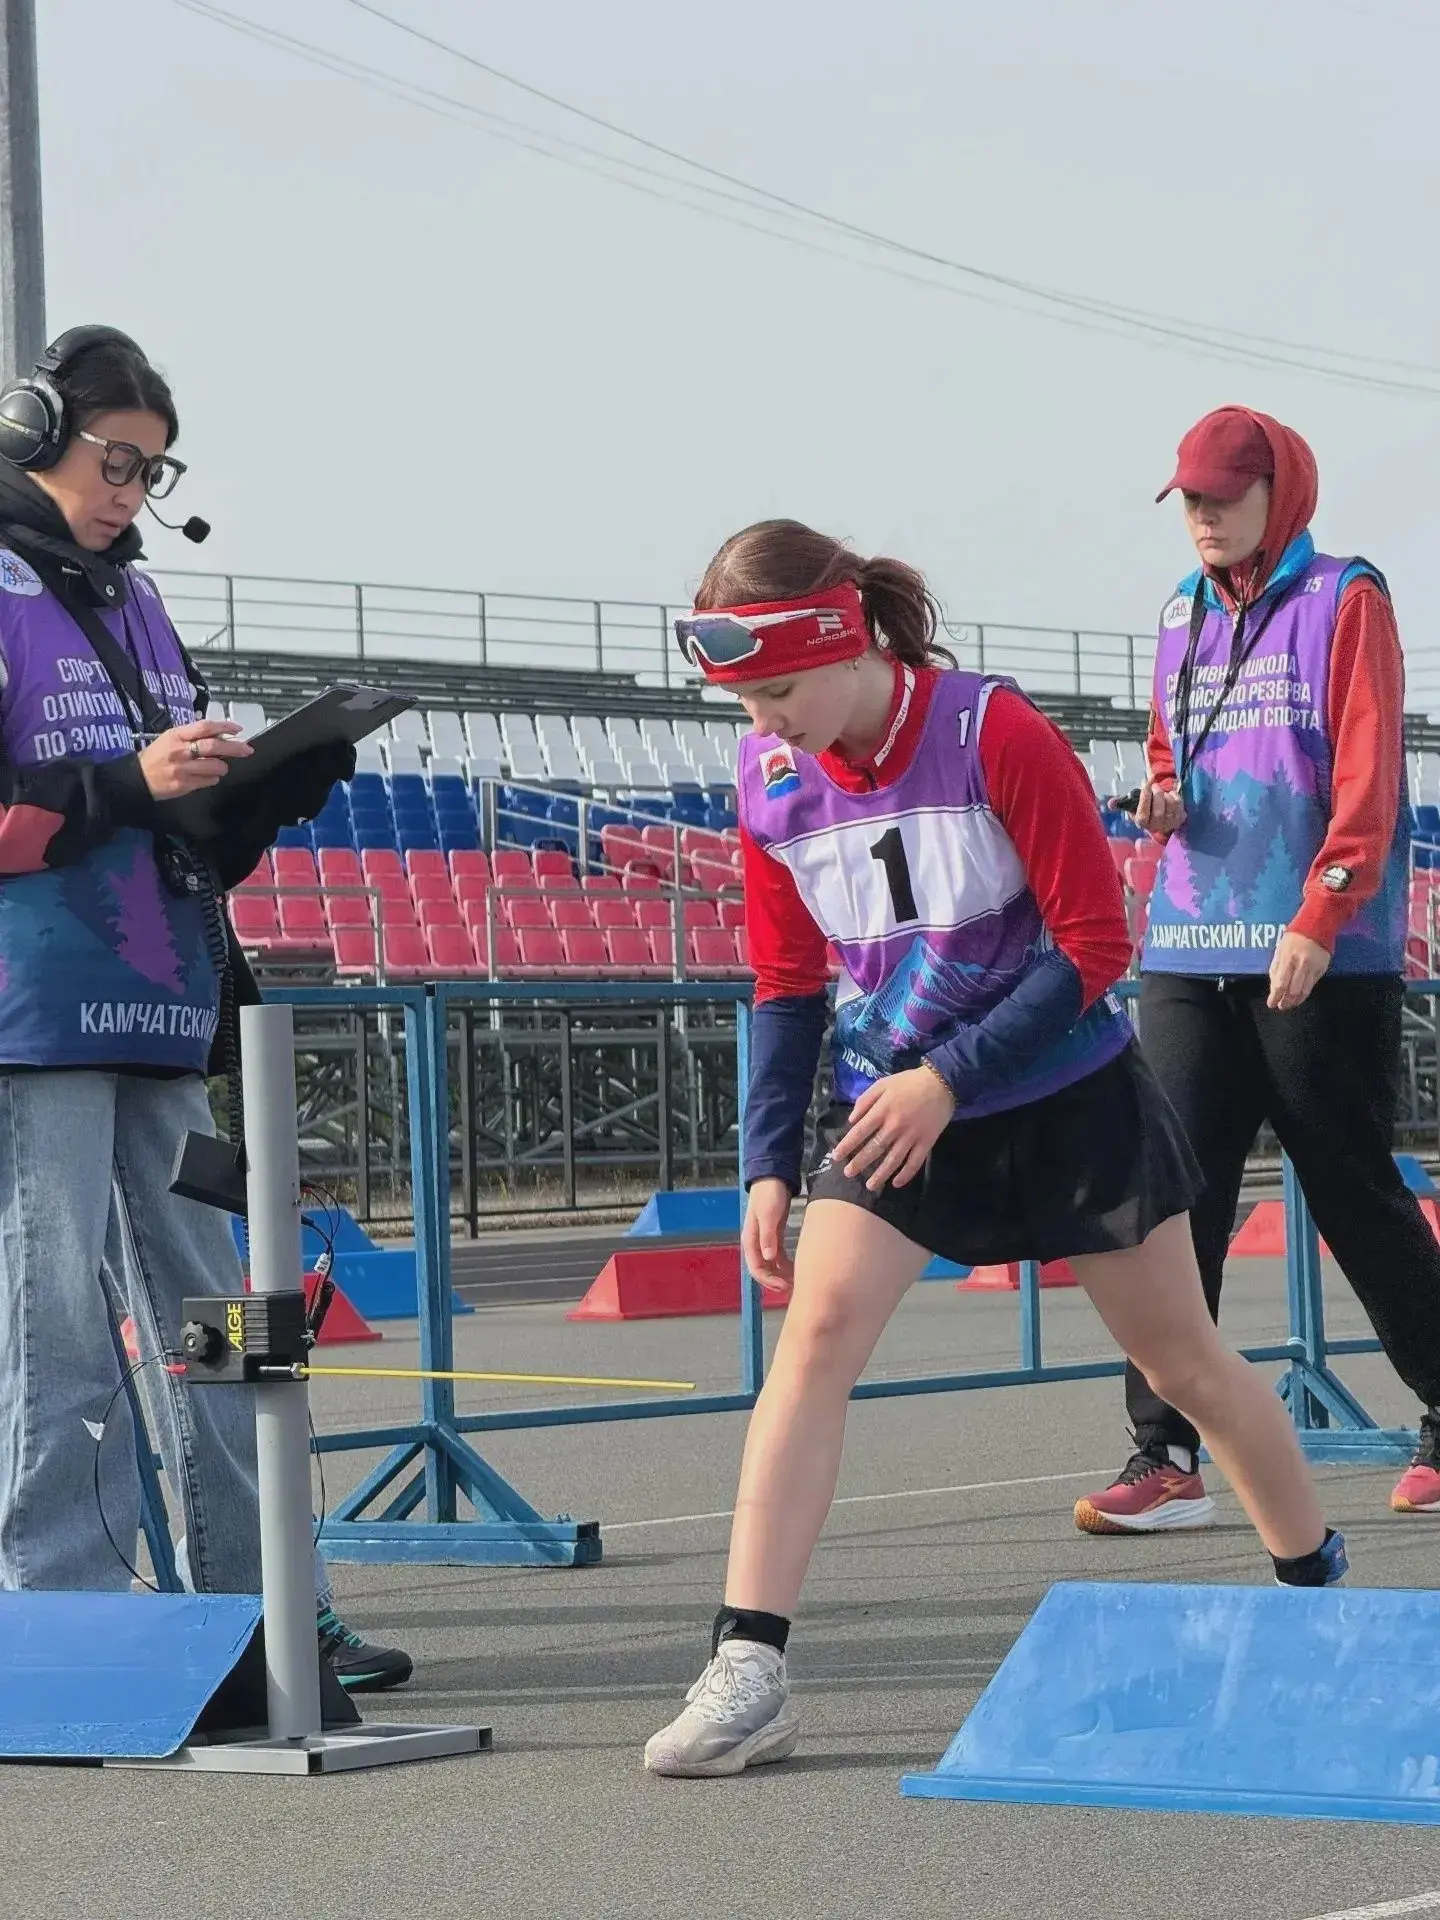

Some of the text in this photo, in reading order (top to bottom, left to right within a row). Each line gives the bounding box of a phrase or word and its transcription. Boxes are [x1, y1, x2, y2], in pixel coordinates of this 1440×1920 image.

[1304, 576, 1324, 593] 15
[806, 627, 857, 646] NORDSKI
[1245, 653, 1297, 678] ШКОЛА
[1249, 679, 1312, 703] РЕЗЕРВА
[957, 706, 972, 748] 1
[1264, 705, 1321, 731] СПОРТА
[33, 730, 67, 761] ПО
[870, 826, 919, 924] 1
[1251, 924, 1287, 949] КРА
[227, 1303, 243, 1352] ALGE
